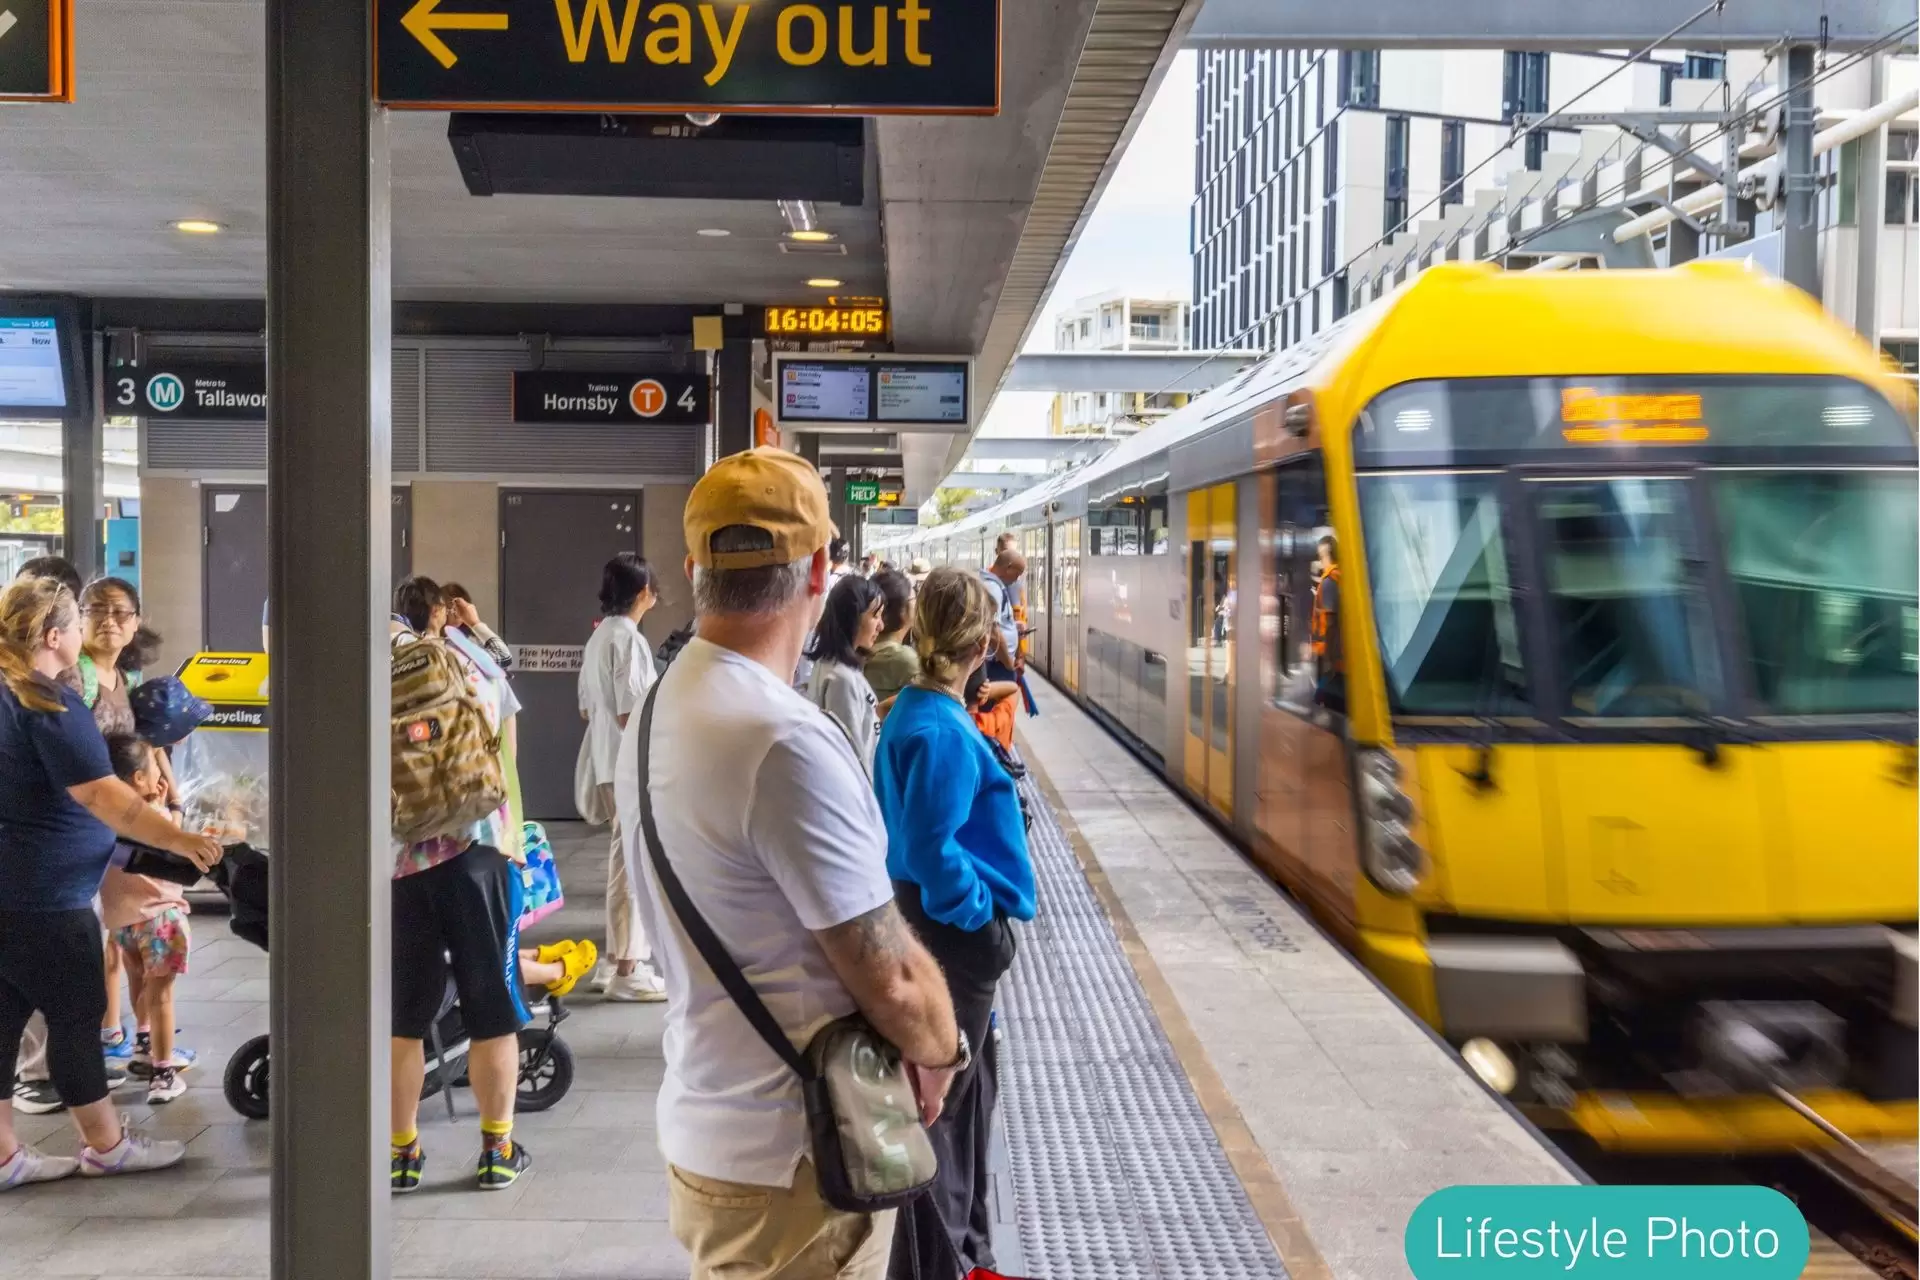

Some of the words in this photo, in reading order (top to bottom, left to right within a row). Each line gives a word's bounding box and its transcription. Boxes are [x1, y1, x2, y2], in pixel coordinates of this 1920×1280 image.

[555, 0, 750, 86] Way
[776, 0, 932, 66] out
[768, 309, 882, 332] 16:04:05
[31, 337, 51, 345] Now
[195, 379, 216, 387] Metro
[588, 384, 609, 392] Trains
[610, 385, 619, 393] to
[117, 378, 136, 405] 3
[544, 393, 619, 415] Hornsby
[677, 385, 697, 412] 4
[851, 490, 877, 500] HELP
[519, 648, 538, 658] Fire
[541, 648, 583, 659] Hydrant
[519, 659, 538, 669] Fire
[541, 659, 567, 669] Hose
[205, 710, 262, 725] ecycling
